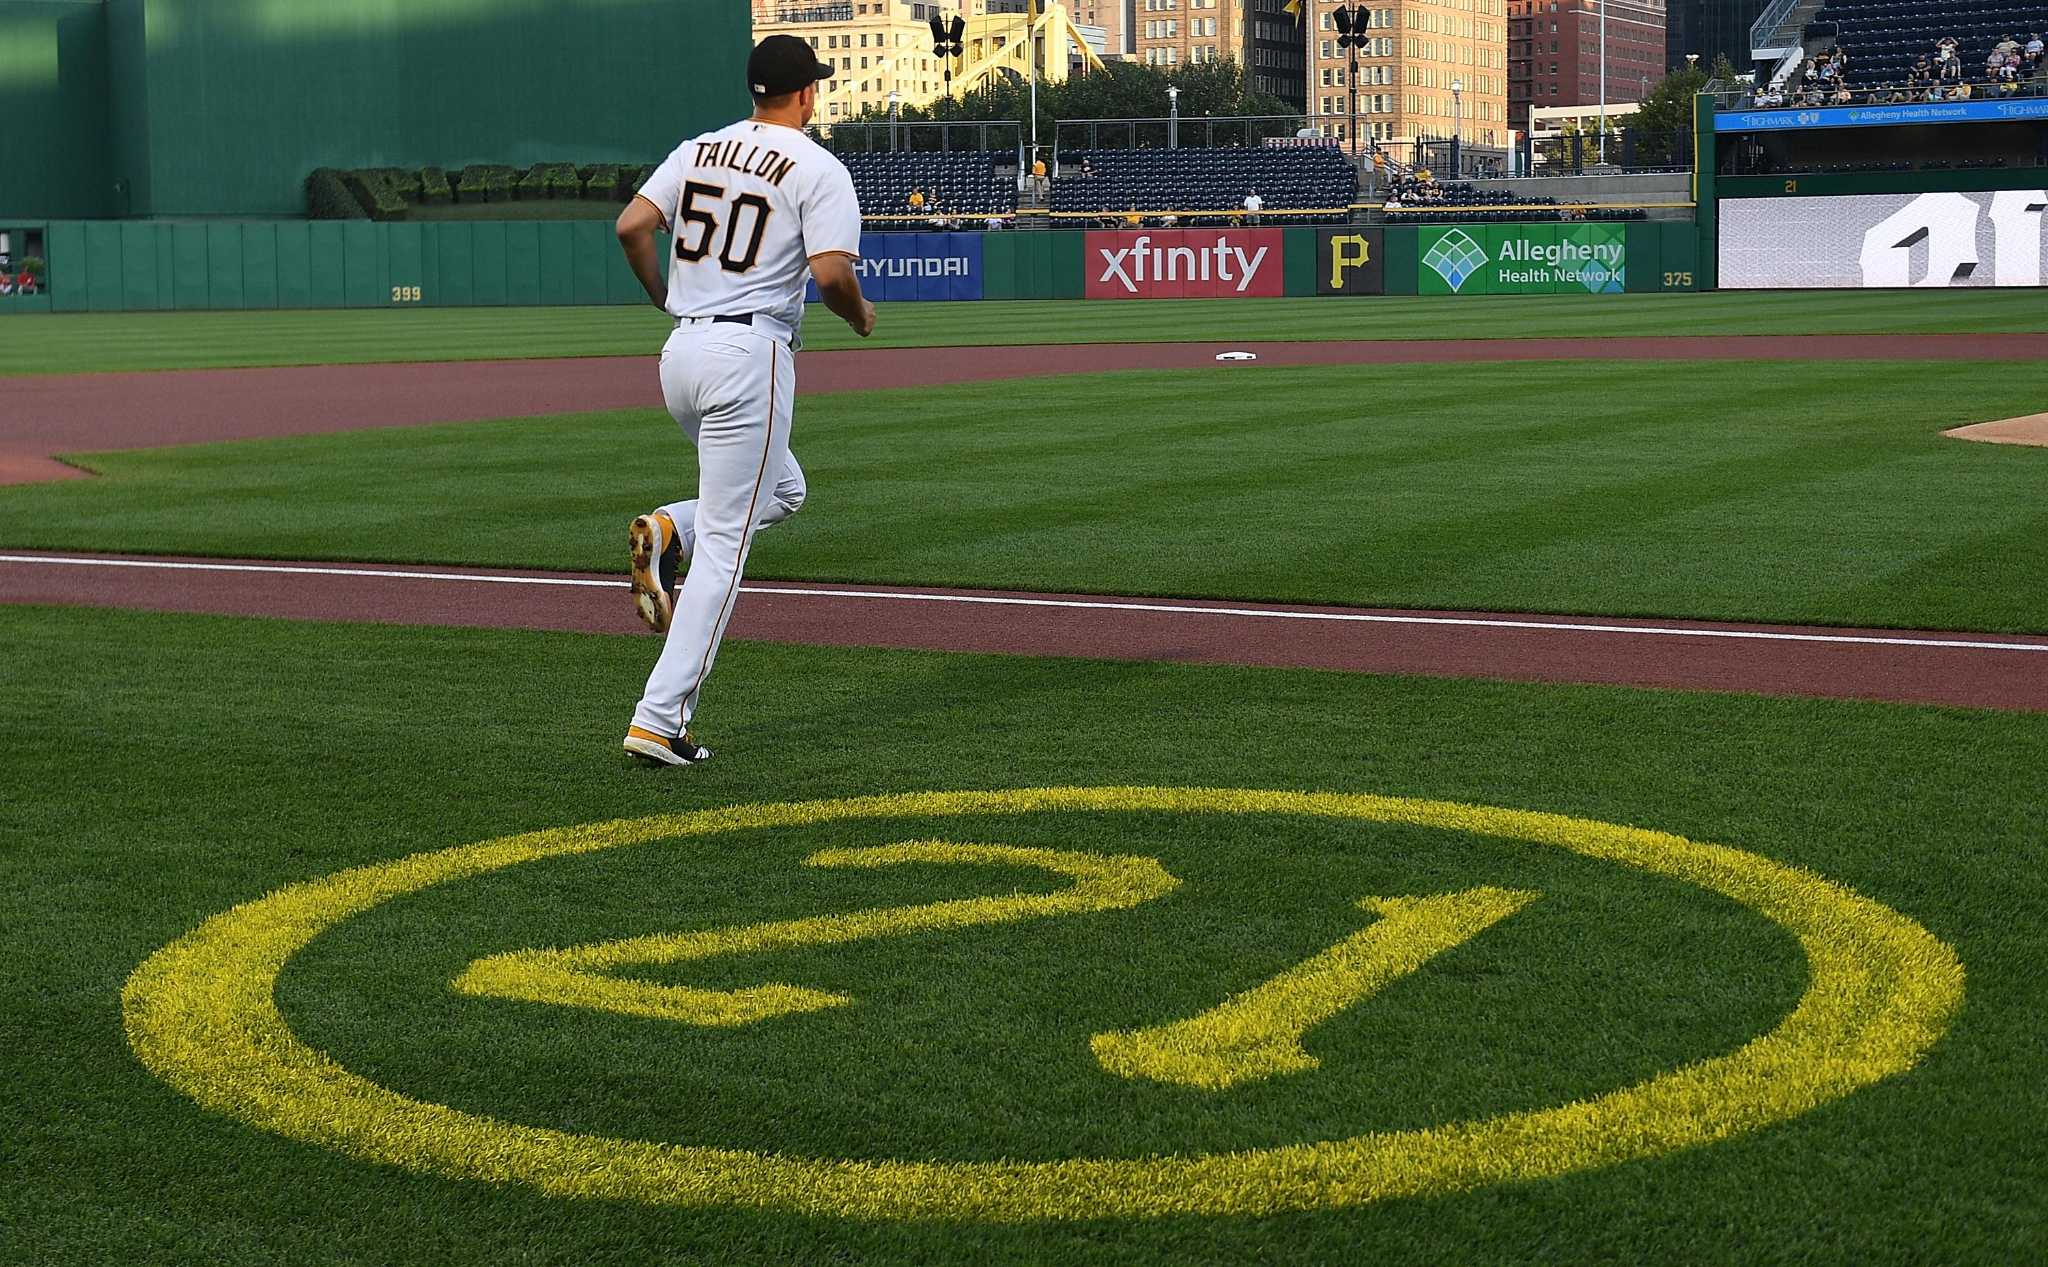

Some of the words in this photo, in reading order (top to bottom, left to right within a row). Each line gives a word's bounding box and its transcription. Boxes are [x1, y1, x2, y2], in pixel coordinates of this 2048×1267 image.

[1861, 111, 1900, 120] Allegheny
[1903, 109, 1929, 117] Health
[1931, 107, 1967, 115] Network
[694, 140, 796, 187] TAILLON
[1785, 180, 1797, 193] 21
[675, 180, 773, 274] 50
[1331, 234, 1369, 289] P
[1498, 239, 1623, 266] Allegheny
[854, 257, 968, 277] HYUNDAI
[1099, 236, 1268, 293] xfinity
[1499, 268, 1549, 282] Health
[1554, 268, 1620, 282] Network
[1664, 271, 1692, 286] 375
[392, 286, 421, 301] 399
